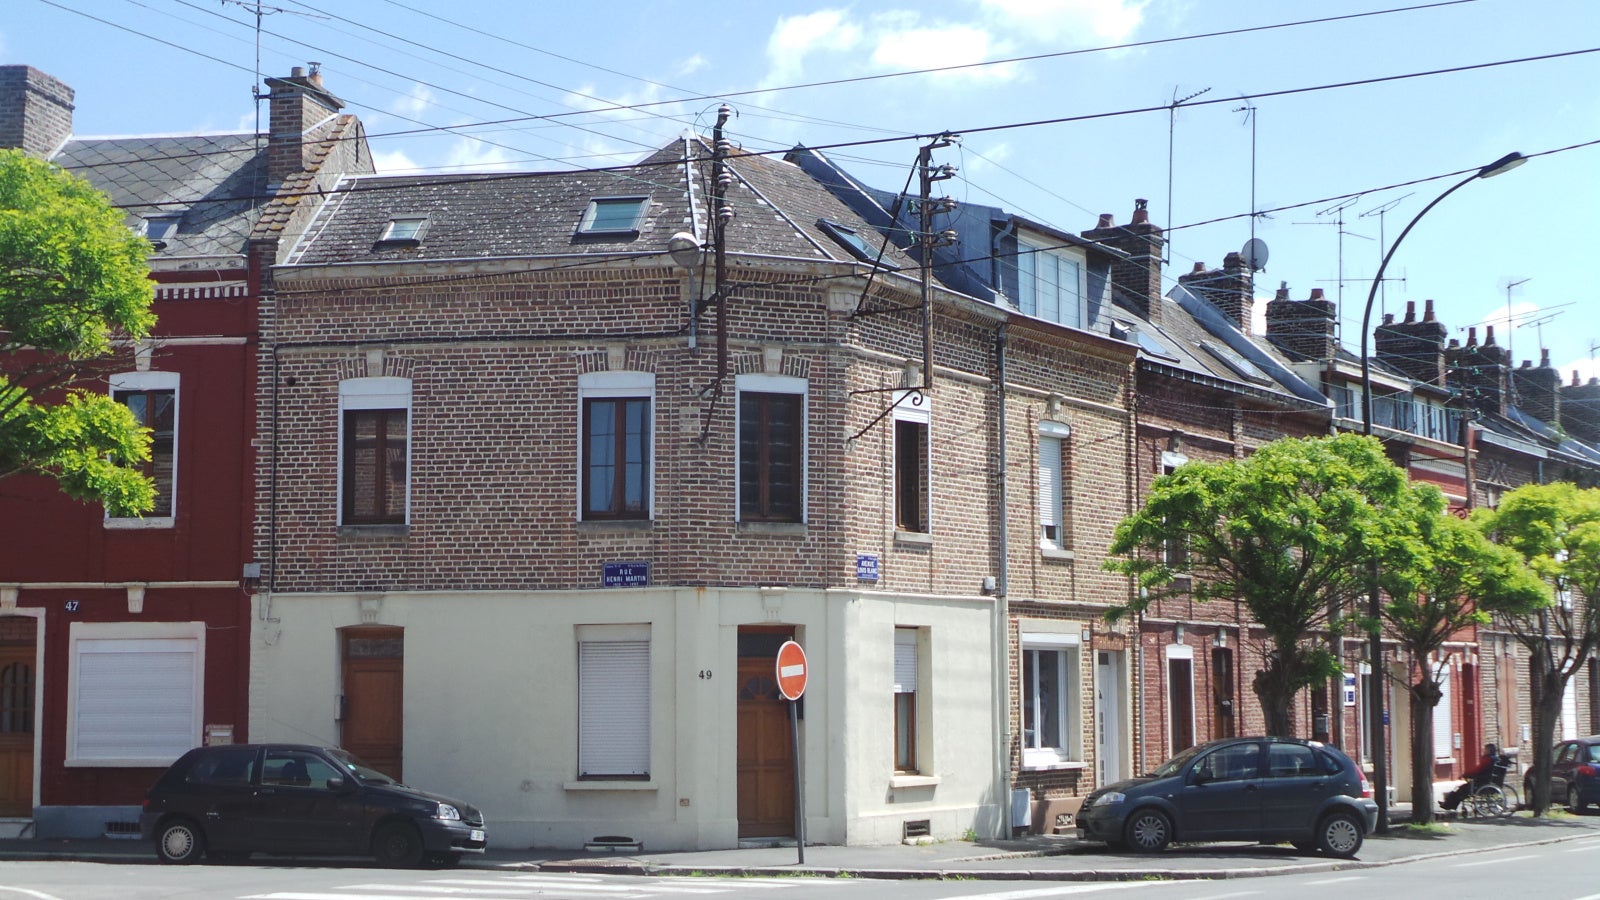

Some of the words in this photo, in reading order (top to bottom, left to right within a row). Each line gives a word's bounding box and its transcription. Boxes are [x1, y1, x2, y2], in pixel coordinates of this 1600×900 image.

[606, 575, 623, 583] HENRI
[65, 601, 79, 611] 47
[698, 669, 712, 680] 49
